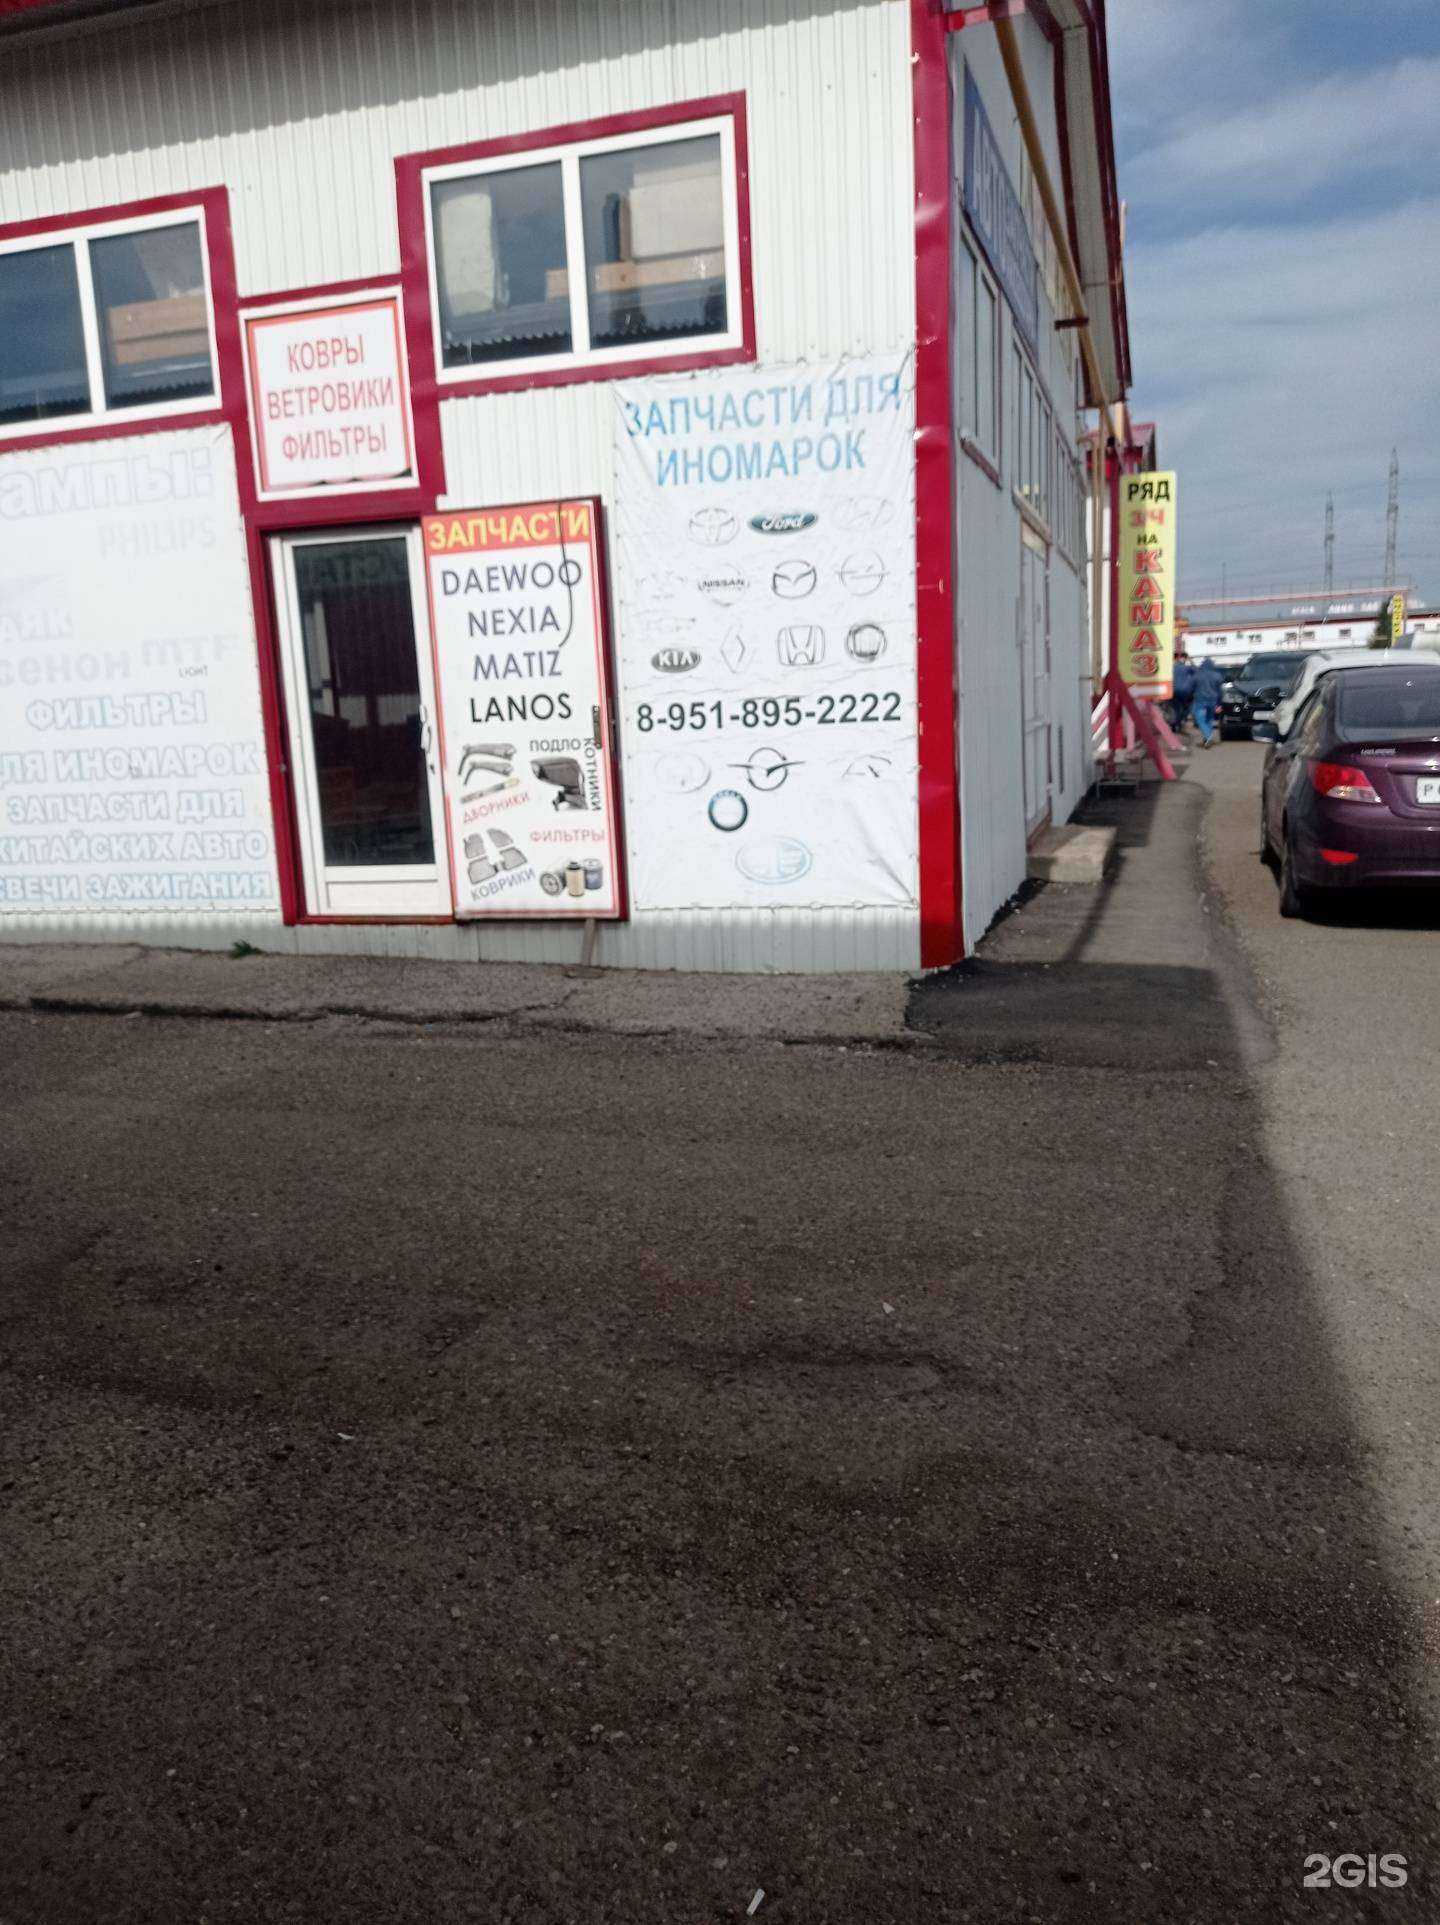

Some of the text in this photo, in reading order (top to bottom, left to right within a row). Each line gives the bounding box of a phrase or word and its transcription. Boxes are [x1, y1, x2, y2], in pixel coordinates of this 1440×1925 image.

[287, 334, 365, 373] КОВРЫ
[267, 377, 395, 420] ВЕТРОВИКИ
[626, 372, 902, 438] ЗАПЧАСТИ ДЛЯ
[282, 424, 388, 462] ФИЛЬТРЫ
[657, 429, 867, 487] ИНОМАРОК
[1127, 480, 1170, 502] РЯД
[97, 511, 216, 560] PHILIPS
[428, 507, 590, 550] ЗАПЧАСТИ
[442, 560, 582, 596] DAEWOO
[702, 577, 745, 589] NISSAN
[468, 605, 561, 637] NEXIA
[1129, 549, 1164, 678] КАМАЗ
[473, 650, 562, 682] MATIZ
[657, 650, 695, 667] KIA
[26, 690, 208, 731] ФИЛЬТРЫ
[470, 692, 573, 724] LANOS
[637, 692, 902, 732] 8-951-895-2222
[53, 741, 262, 782] ИНОМАРОК
[8, 788, 246, 824] ЗАПЧАСТИ ДЛЯ
[463, 792, 530, 825] ДВОРНИКИ
[179, 830, 270, 861] АВТО
[529, 828, 606, 844] ФИЛЬТРЫ
[0, 871, 275, 904] ВЕЧИ ЗАЖИГАНИЯ
[470, 868, 537, 902] КОВРИКИ
